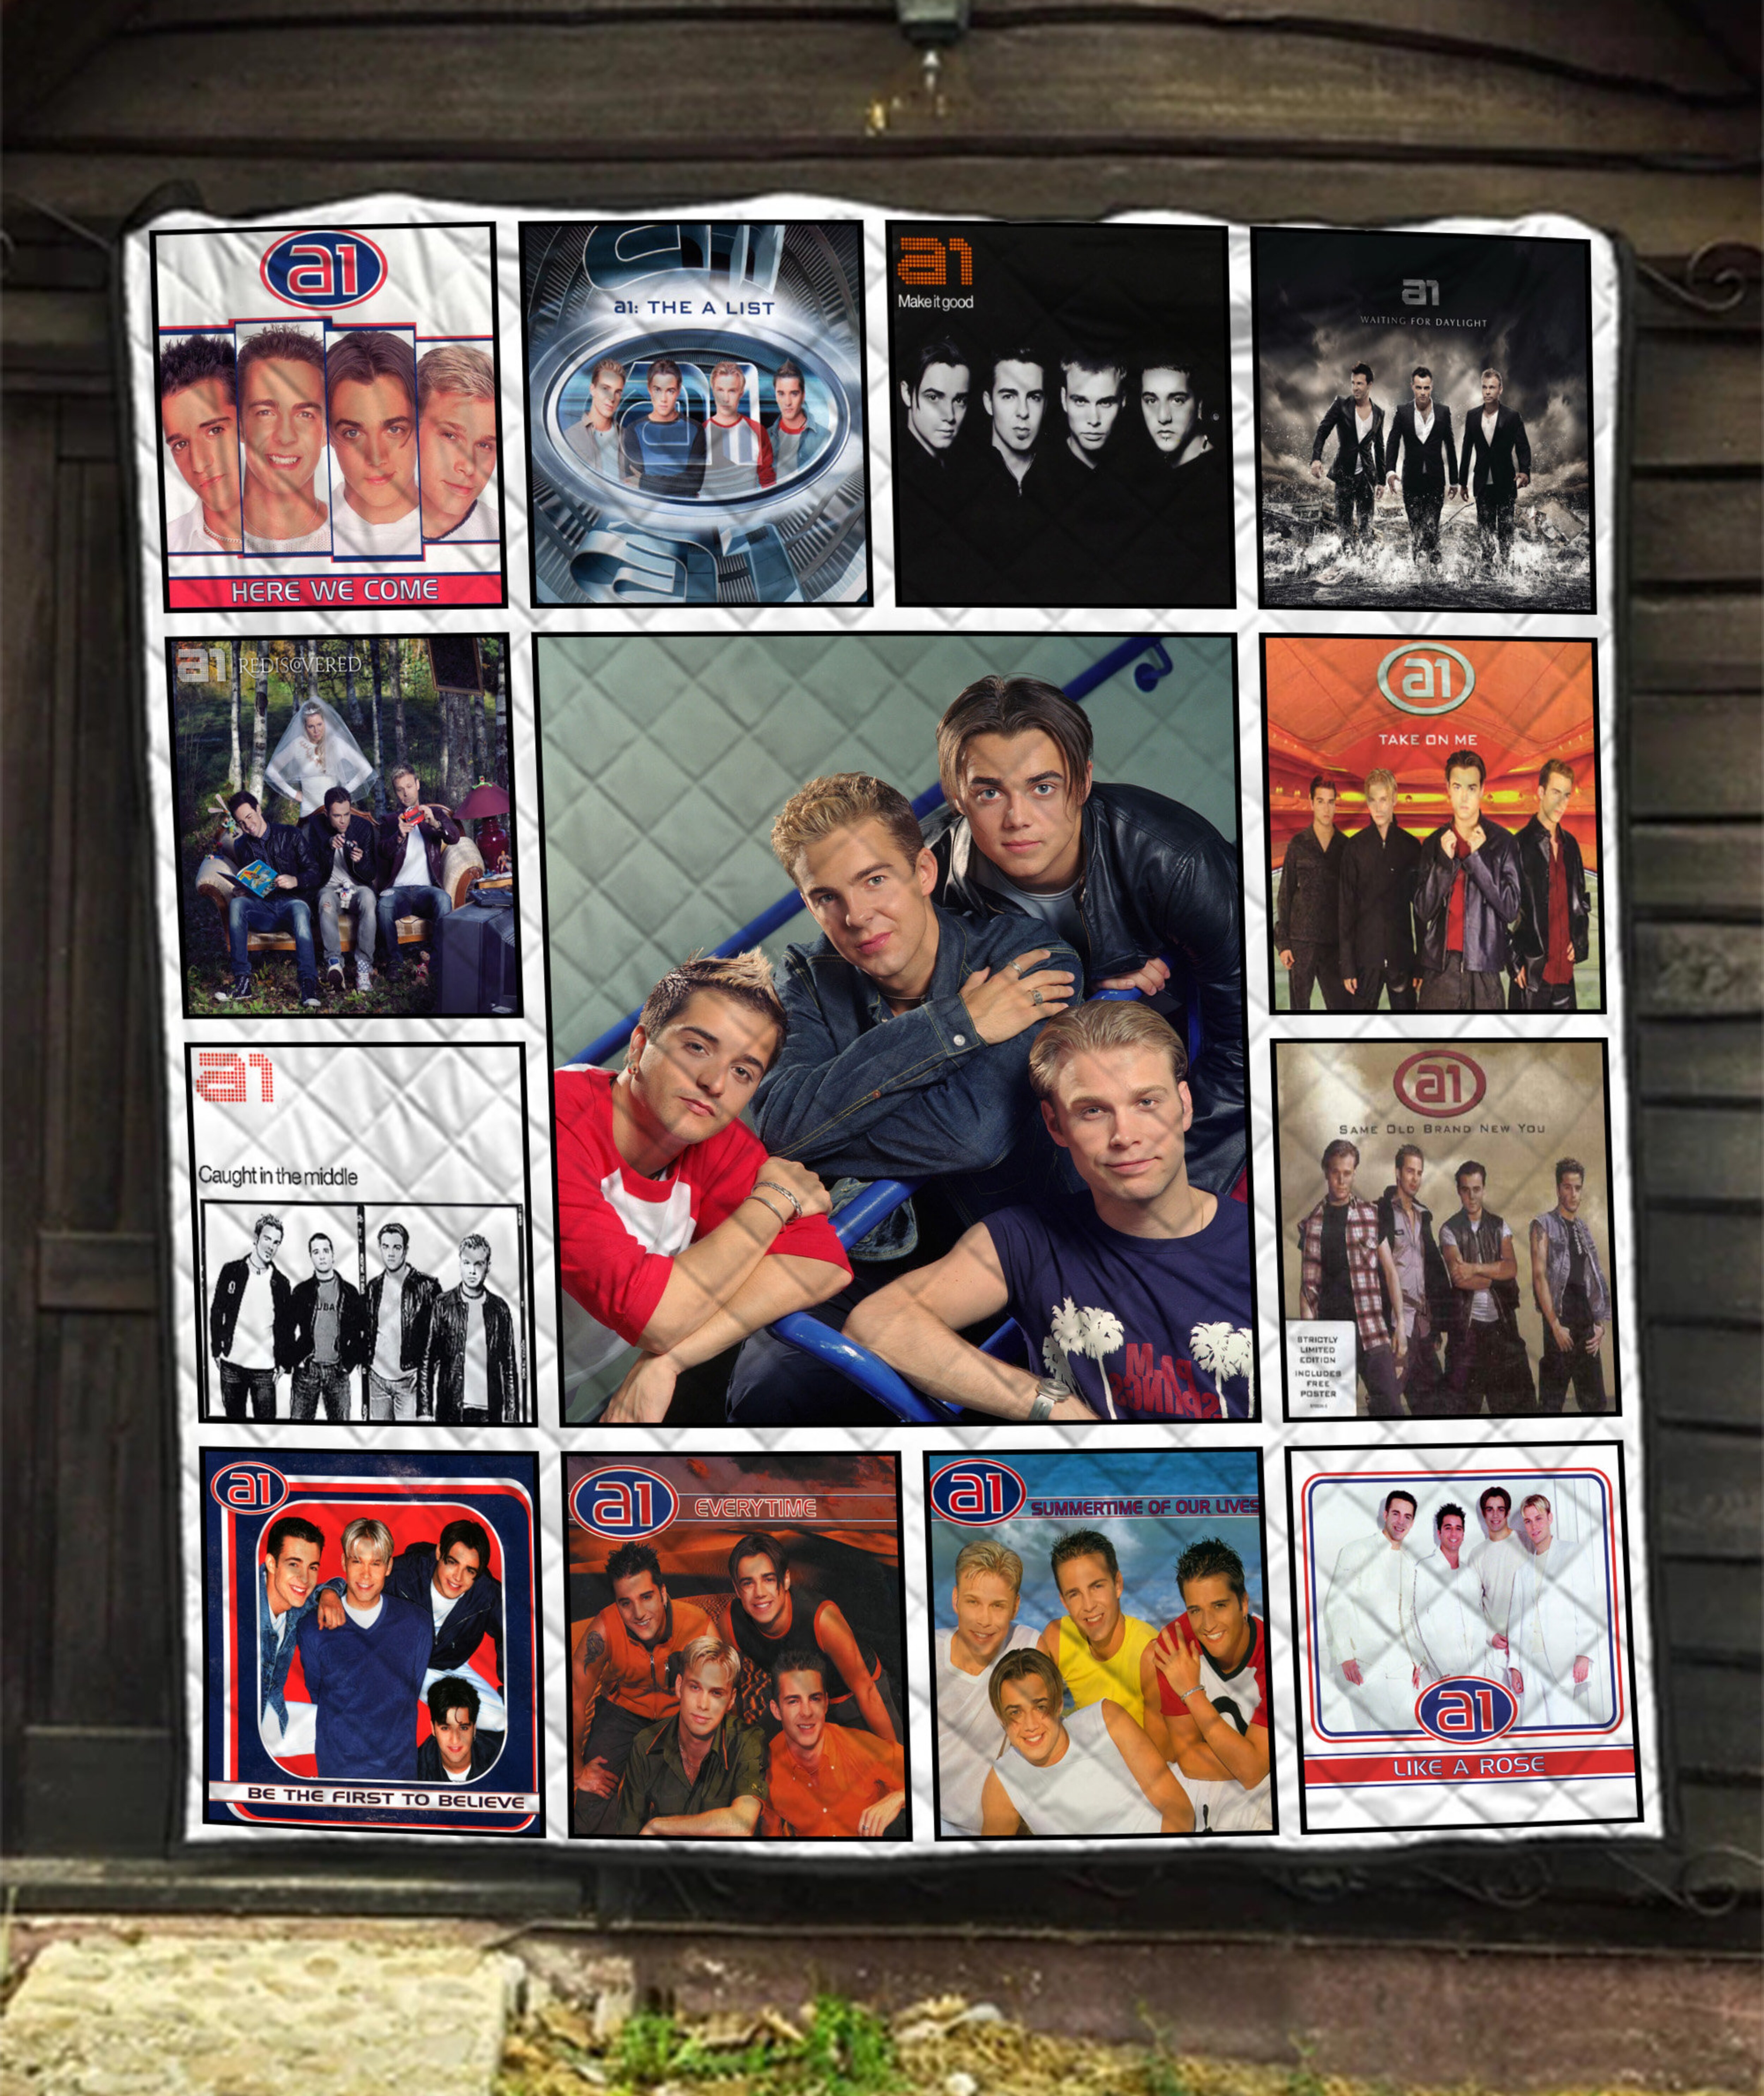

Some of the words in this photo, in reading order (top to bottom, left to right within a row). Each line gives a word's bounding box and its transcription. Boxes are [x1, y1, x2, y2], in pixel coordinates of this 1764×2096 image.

[287, 244, 358, 296] a1
[898, 237, 972, 285] a1
[899, 294, 932, 308] Make
[934, 295, 940, 308] it
[942, 295, 974, 312] good
[1402, 279, 1439, 306] a1
[614, 301, 638, 314] a1:
[647, 301, 691, 314] THE
[702, 302, 716, 314] A
[726, 302, 775, 315] LIST
[1360, 316, 1406, 325] WAITING
[1411, 317, 1431, 326] FOR
[1436, 318, 1487, 327] DAYLIGHT
[231, 581, 300, 602] HERE
[310, 580, 353, 601] WE
[363, 579, 438, 600] COME
[177, 648, 226, 682] a1
[1402, 658, 1451, 698] a1
[1378, 734, 1420, 745] TAKE
[1426, 734, 1449, 745] ON
[1455, 734, 1478, 746] ME
[196, 1053, 274, 1102] a1
[1415, 1064, 1462, 1103] a1
[198, 1165, 257, 1188] Caught
[260, 1167, 273, 1184] in
[276, 1167, 302, 1184] the
[304, 1167, 358, 1185] middle
[228, 1472, 270, 1505] a1
[949, 1473, 1003, 1514] a1
[593, 1481, 653, 1527] a1
[695, 1498, 817, 1518] EVERYTIME
[1031, 1501, 1143, 1516] SUMMERTIME
[1148, 1500, 1171, 1514] OF
[1176, 1500, 1210, 1514] OUR
[1216, 1499, 1258, 1513] LIVES
[1437, 1689, 1494, 1733] a1
[1394, 1759, 1443, 1776] LIKE
[1453, 1759, 1469, 1775] A
[1480, 1756, 1545, 1774] ROSE
[248, 1787, 275, 1800] BE
[284, 1789, 323, 1802] THE
[332, 1791, 394, 1805] FIRST
[402, 1793, 430, 1806] TO
[438, 1795, 524, 1809] BELIEVE
